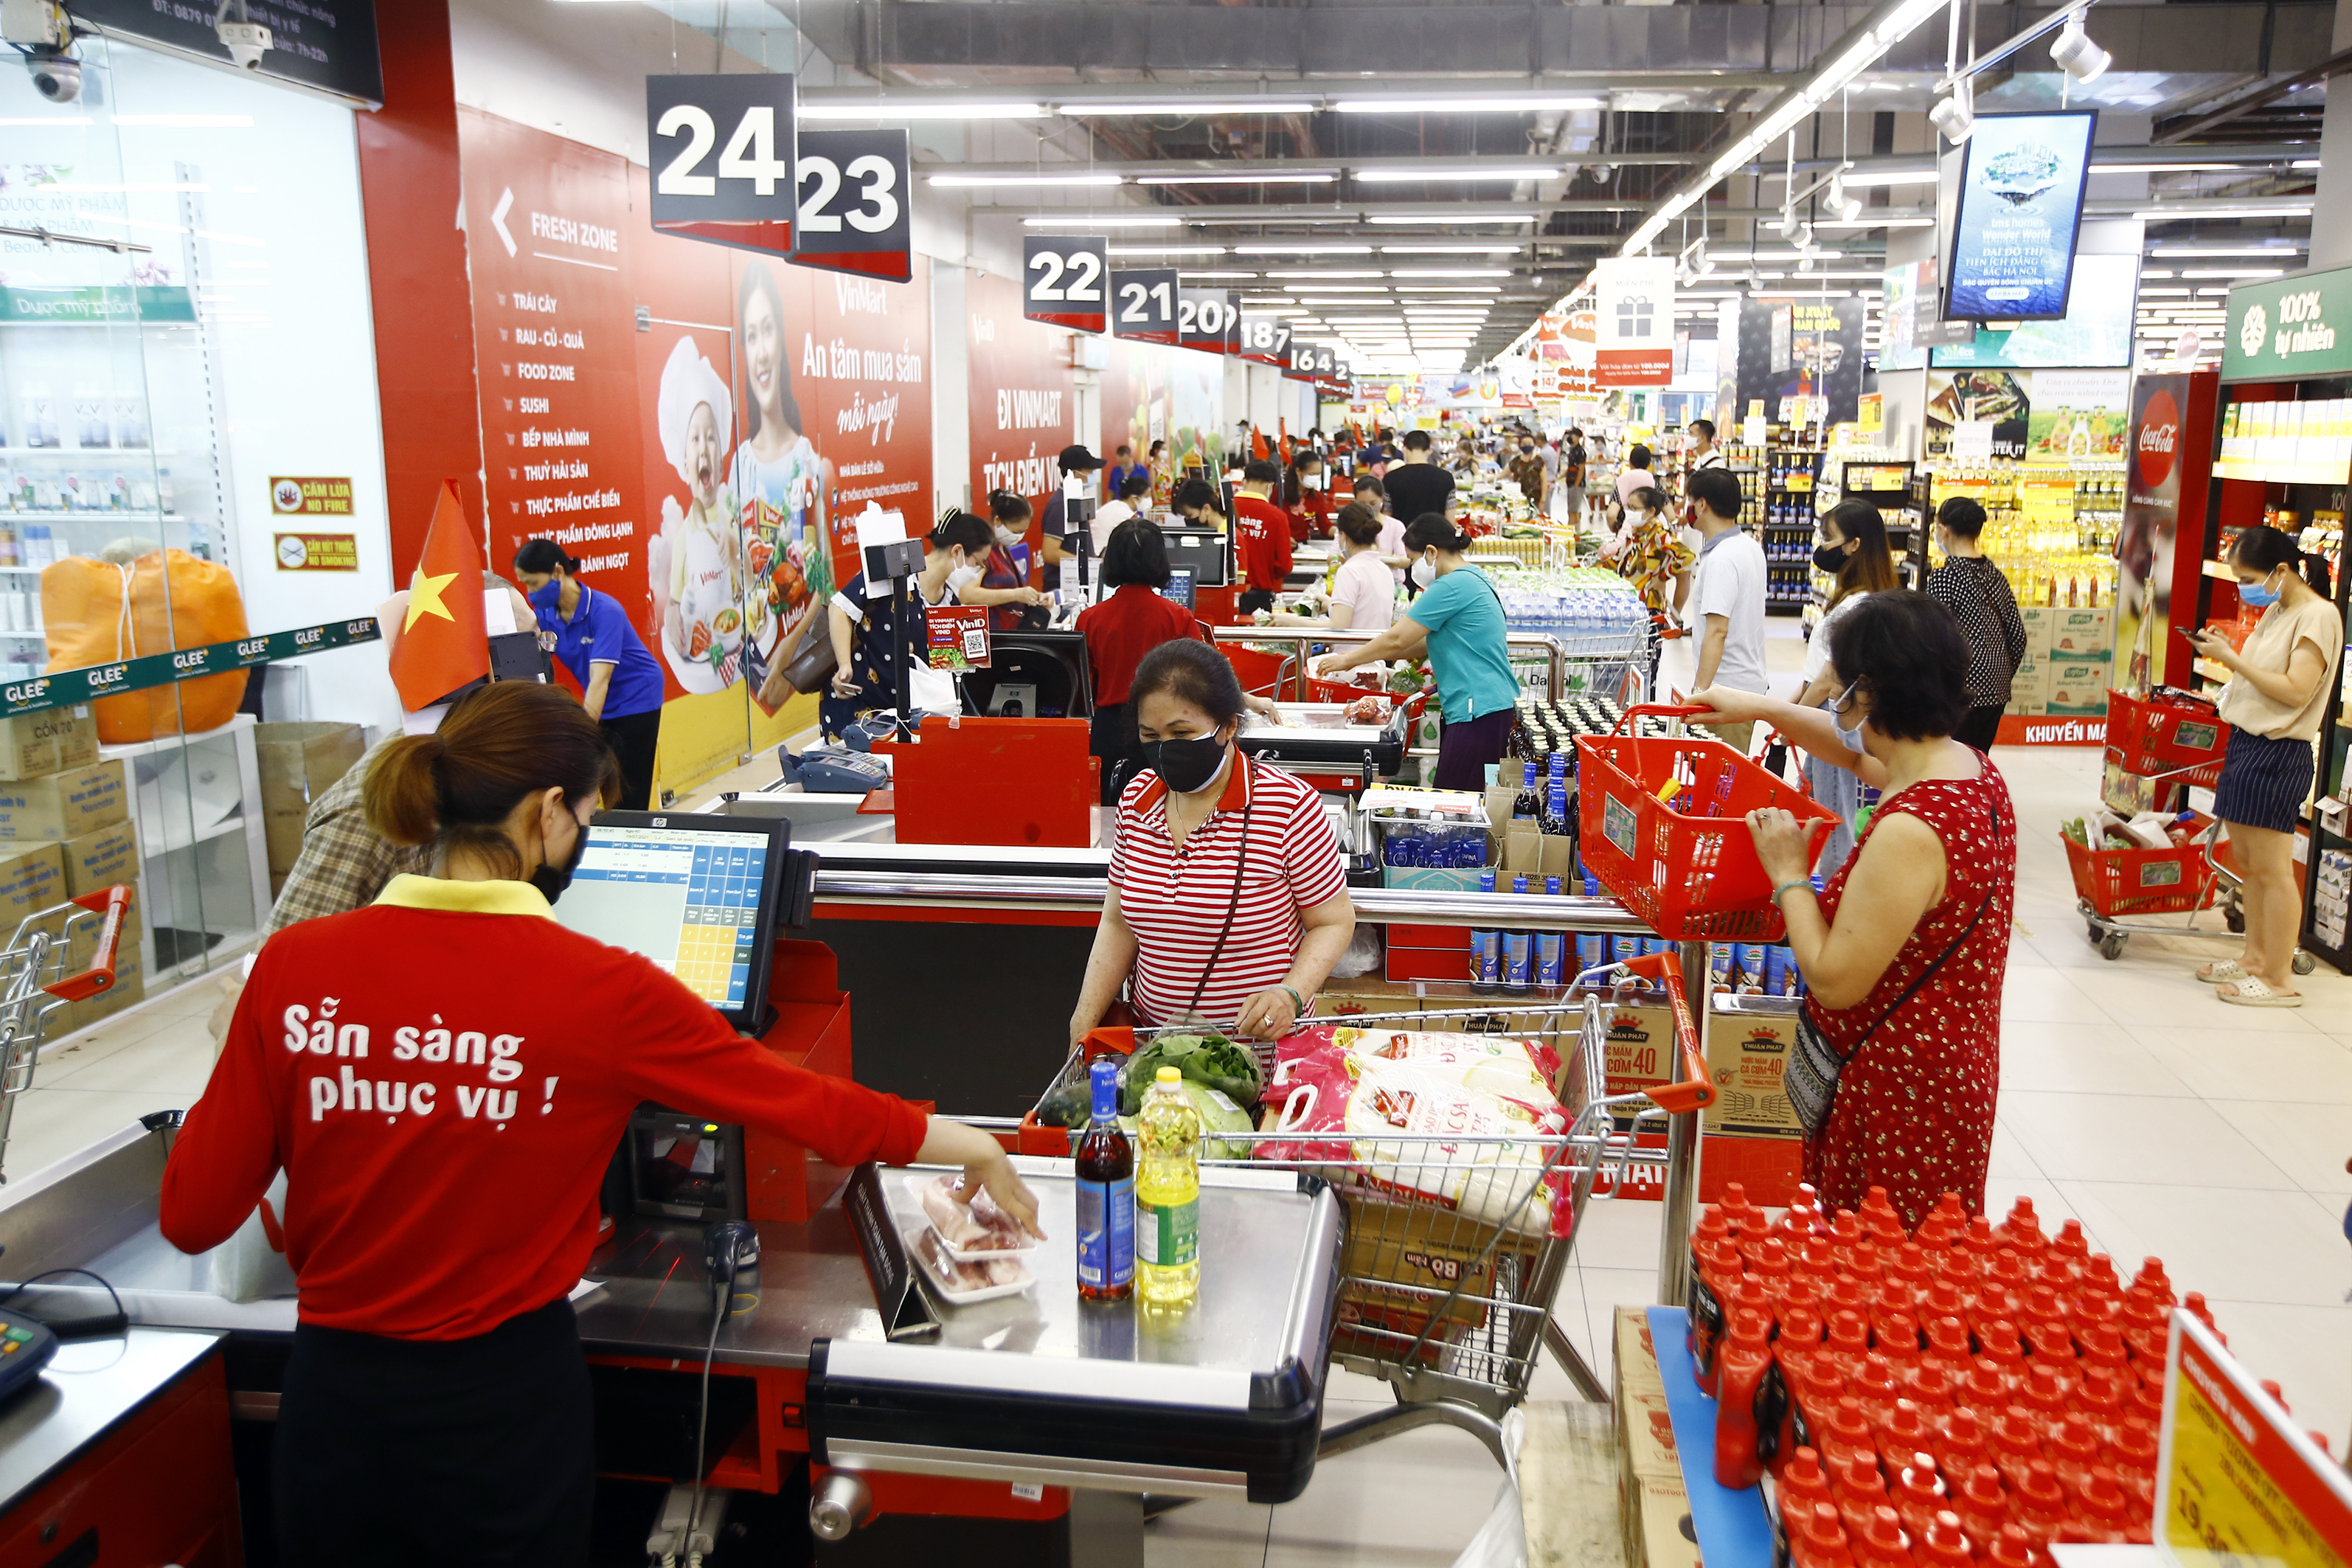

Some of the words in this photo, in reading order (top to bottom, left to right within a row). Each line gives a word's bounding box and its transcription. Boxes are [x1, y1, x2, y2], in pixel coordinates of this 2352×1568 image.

[656, 104, 785, 196] 24
[798, 155, 899, 234] 23
[532, 212, 577, 243] FRESH
[580, 220, 617, 251] ZONE
[1982, 229, 2019, 240] Wonder
[2022, 228, 2051, 239] World
[1028, 251, 1101, 302] 22
[513, 292, 536, 311] TRÁI
[538, 293, 557, 313] CÂY
[834, 272, 887, 316] VinMart
[1118, 282, 1172, 323] 21
[1180, 299, 1224, 334] 20
[2279, 291, 2322, 324] 100%
[516, 328, 536, 344] RAU
[544, 327, 557, 346] CỦ
[563, 330, 584, 349] QUẢ
[1241, 322, 1274, 349] 18
[2275, 330, 2292, 359] tự
[2292, 322, 2335, 353] nhiên
[802, 333, 827, 378] An
[830, 337, 860, 380] tâm
[864, 350, 893, 381] mua
[896, 338, 922, 383] sắm
[1291, 350, 1315, 371] 16
[518, 362, 547, 379] FOOD
[549, 364, 575, 381] ZONE
[1542, 377, 1555, 386] 147
[520, 397, 549, 413] SUSHI
[997, 389, 1011, 430] ĐI
[1013, 389, 1062, 429] VINMART
[837, 391, 866, 435] mỗi
[867, 390, 899, 447] ngày!
[522, 426, 541, 447] BẾP
[543, 428, 563, 447] NHÀ
[565, 429, 589, 445] MÌNH
[553, 459, 569, 479] HẢI
[570, 459, 589, 479] SẢN
[1016, 441, 1045, 497] ĐIỂM
[307, 499, 322, 511] NO
[325, 500, 349, 512] FIRE
[526, 496, 553, 517] THỰC
[555, 491, 581, 512] PHẨM
[583, 489, 600, 510] CHẾ
[601, 488, 620, 508] BIẾN
[556, 523, 583, 545] PHẨM
[584, 523, 611, 541] ĐÔNG
[611, 521, 633, 541] LẠNH
[1240, 516, 1263, 530] sàng
[1249, 530, 1260, 540] vụ
[309, 556, 320, 566] NO
[321, 556, 356, 566] SMOKING
[580, 555, 605, 575] BÁNH
[606, 552, 629, 571] NGỌT
[956, 618, 985, 631] VinID
[237, 640, 266, 656] GLEE
[295, 630, 321, 646] GLEE
[173, 651, 205, 669] GLEE
[88, 667, 123, 687] GLEE
[5, 682, 46, 702] GLEE
[2026, 721, 2083, 743] KHUYẾN
[1524, 873, 1540, 881] (028)
[283, 997, 370, 1058] Sẵn
[394, 1014, 524, 1082] sàng
[1607, 1058, 1631, 1073] CƠM
[1633, 1047, 1657, 1075] 40
[1751, 1064, 1767, 1075] CƠM
[1767, 1058, 1782, 1075] 40
[311, 1065, 436, 1125] phục
[457, 1084, 519, 1131] vụ
[541, 1076, 560, 1115] !
